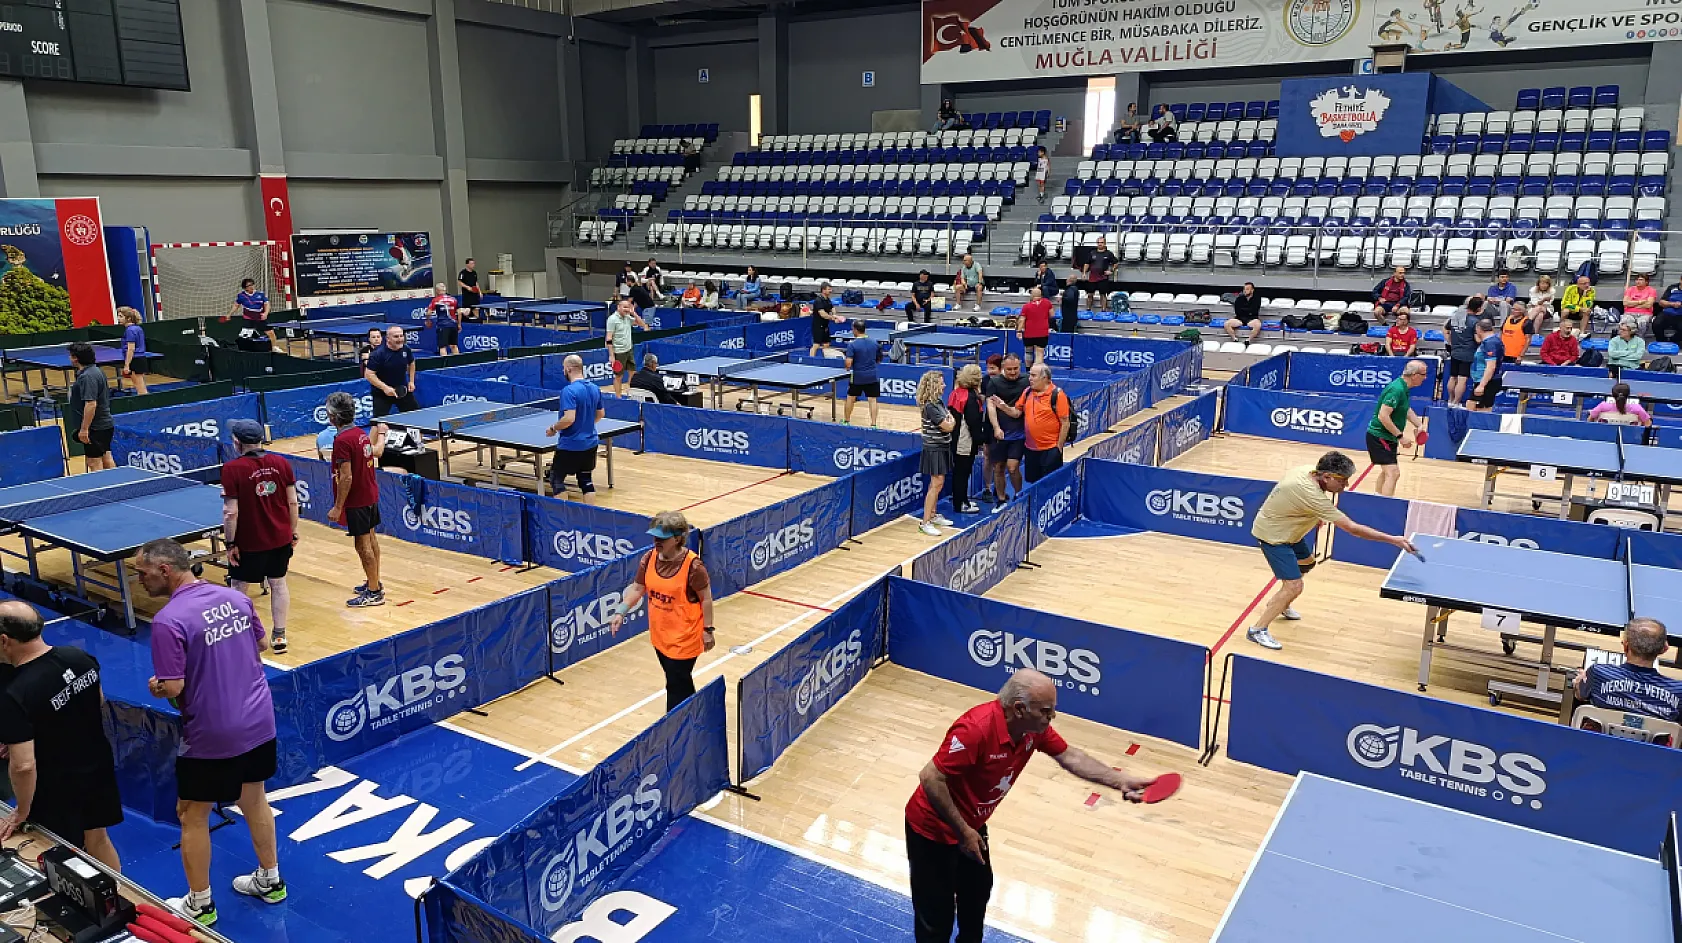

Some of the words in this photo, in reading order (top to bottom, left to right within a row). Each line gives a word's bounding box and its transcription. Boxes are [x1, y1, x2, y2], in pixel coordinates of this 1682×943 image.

[1024, 8, 1118, 30] HOŞGÖRÜNÜN
[1123, 4, 1170, 21] HAKİM
[1174, 0, 1236, 16] OLDUĞU
[1528, 15, 1607, 33] GENÇLİK
[1611, 14, 1636, 27] VE
[1640, 12, 1682, 26] SPO
[1000, 30, 1086, 48] CENTİLMENCE
[1090, 27, 1115, 42] BİR,
[1119, 23, 1199, 39] MÜSABAKA
[1203, 17, 1263, 33] DİLERİZ.
[31, 40, 61, 56] SCORE
[1035, 47, 1113, 70] MUĞLA
[1120, 37, 1218, 64] VALİLİĞİ
[864, 72, 873, 83] B
[1320, 111, 1377, 124] BASKETBOLLA
[773, 329, 795, 343] KBS
[583, 363, 614, 379] KBS
[1118, 350, 1155, 364] KBS
[879, 378, 917, 395] KBS
[1346, 369, 1393, 384] KBS
[1290, 408, 1344, 430] KBS
[703, 428, 749, 449] KBS
[142, 451, 183, 474] KBS
[889, 473, 924, 505] KBS
[1047, 485, 1071, 515] KBS
[421, 504, 473, 534] KBS
[1172, 489, 1244, 520] KBS
[768, 517, 814, 558] KBS
[964, 541, 998, 584] KBS
[202, 601, 240, 624] EROL
[1496, 614, 1506, 627] 7
[203, 615, 252, 647] ÖZGÖZ
[816, 629, 862, 692] KBS
[1004, 631, 1101, 684] KBS
[366, 653, 467, 720] KBS
[1601, 677, 1634, 695] MERSİN
[1644, 682, 1680, 709] VETERAN
[370, 713, 399, 731] TABLE
[399, 700, 434, 719] TENNIS
[1400, 726, 1547, 796] KBS
[1400, 767, 1437, 786] TABLE
[1439, 777, 1488, 797] TENNIS
[575, 773, 662, 875] KBS
[580, 862, 605, 888] TABLE
[604, 836, 634, 866] TENNIS
